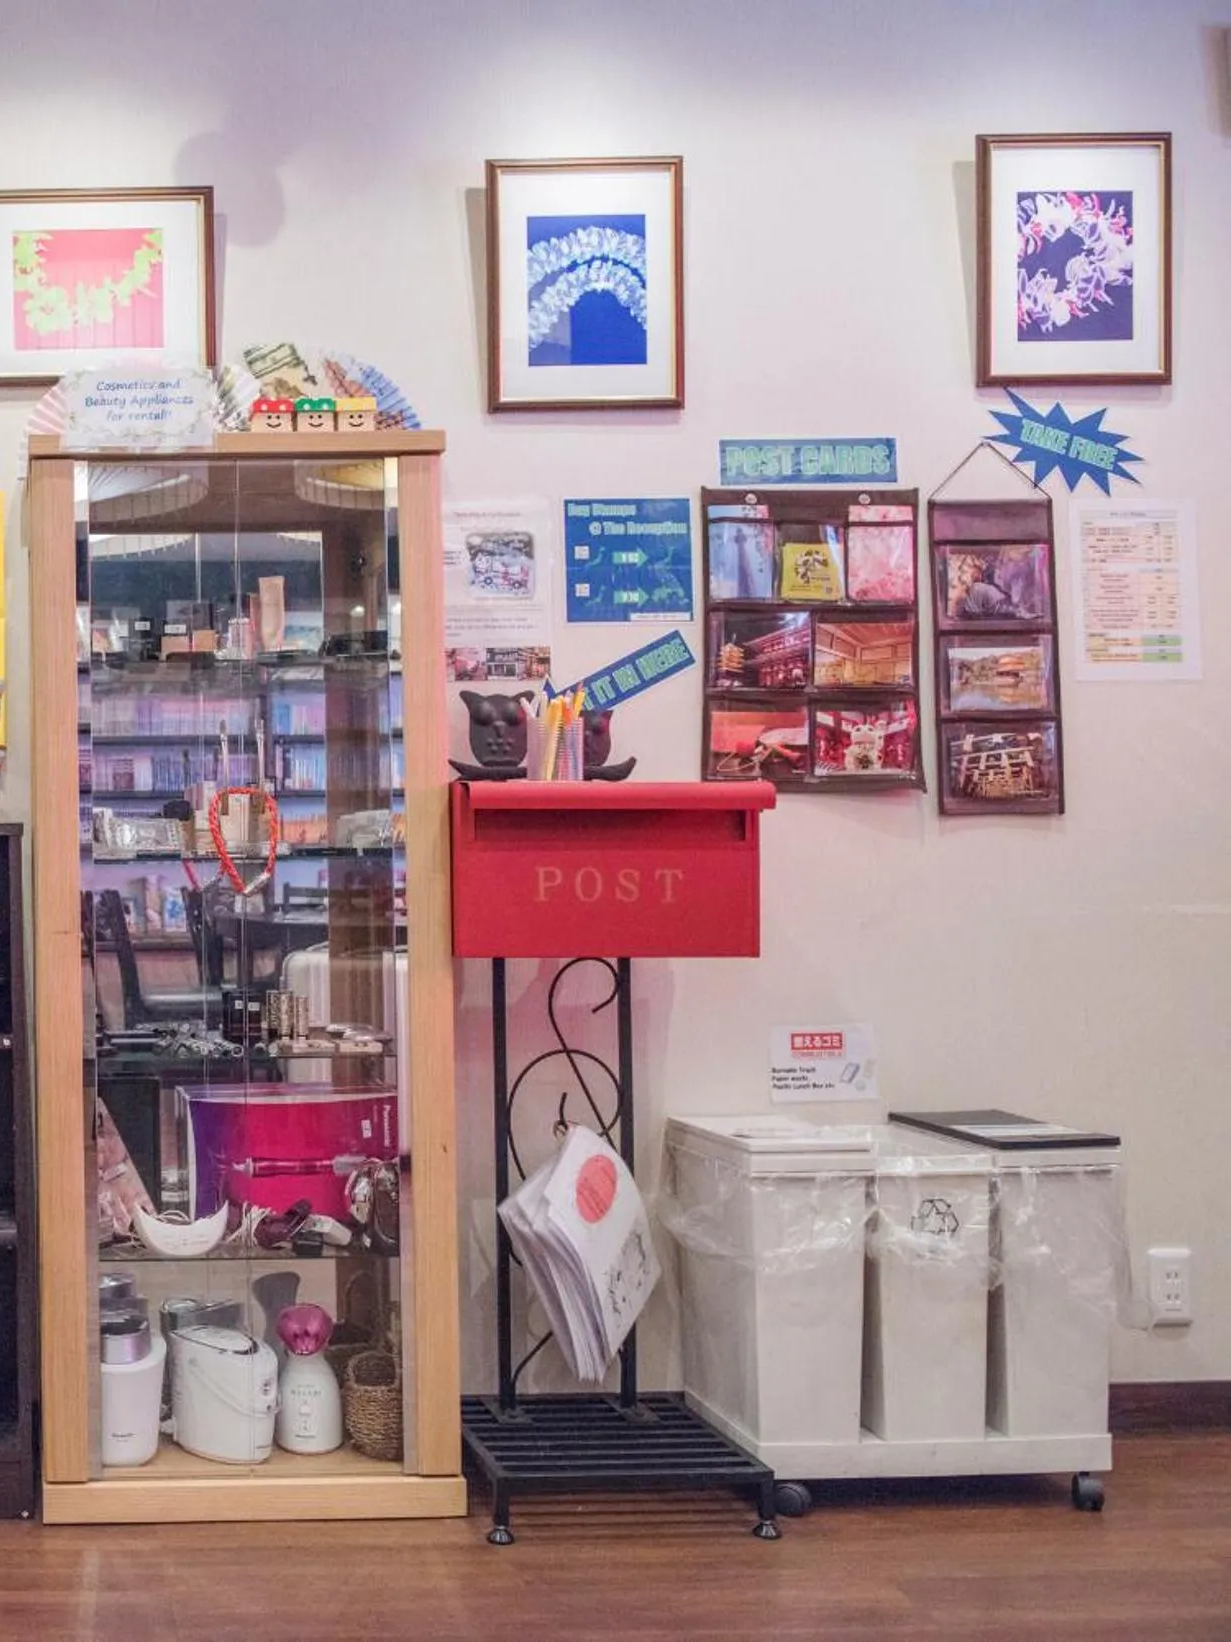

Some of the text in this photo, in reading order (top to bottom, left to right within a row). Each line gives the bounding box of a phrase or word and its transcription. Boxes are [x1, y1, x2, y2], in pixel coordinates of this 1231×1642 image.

[85, 396, 126, 409] Beauty
[725, 444, 890, 476] POST CARDS
[1020, 418, 1118, 471] TAKE FREE
[534, 865, 685, 904] POST
